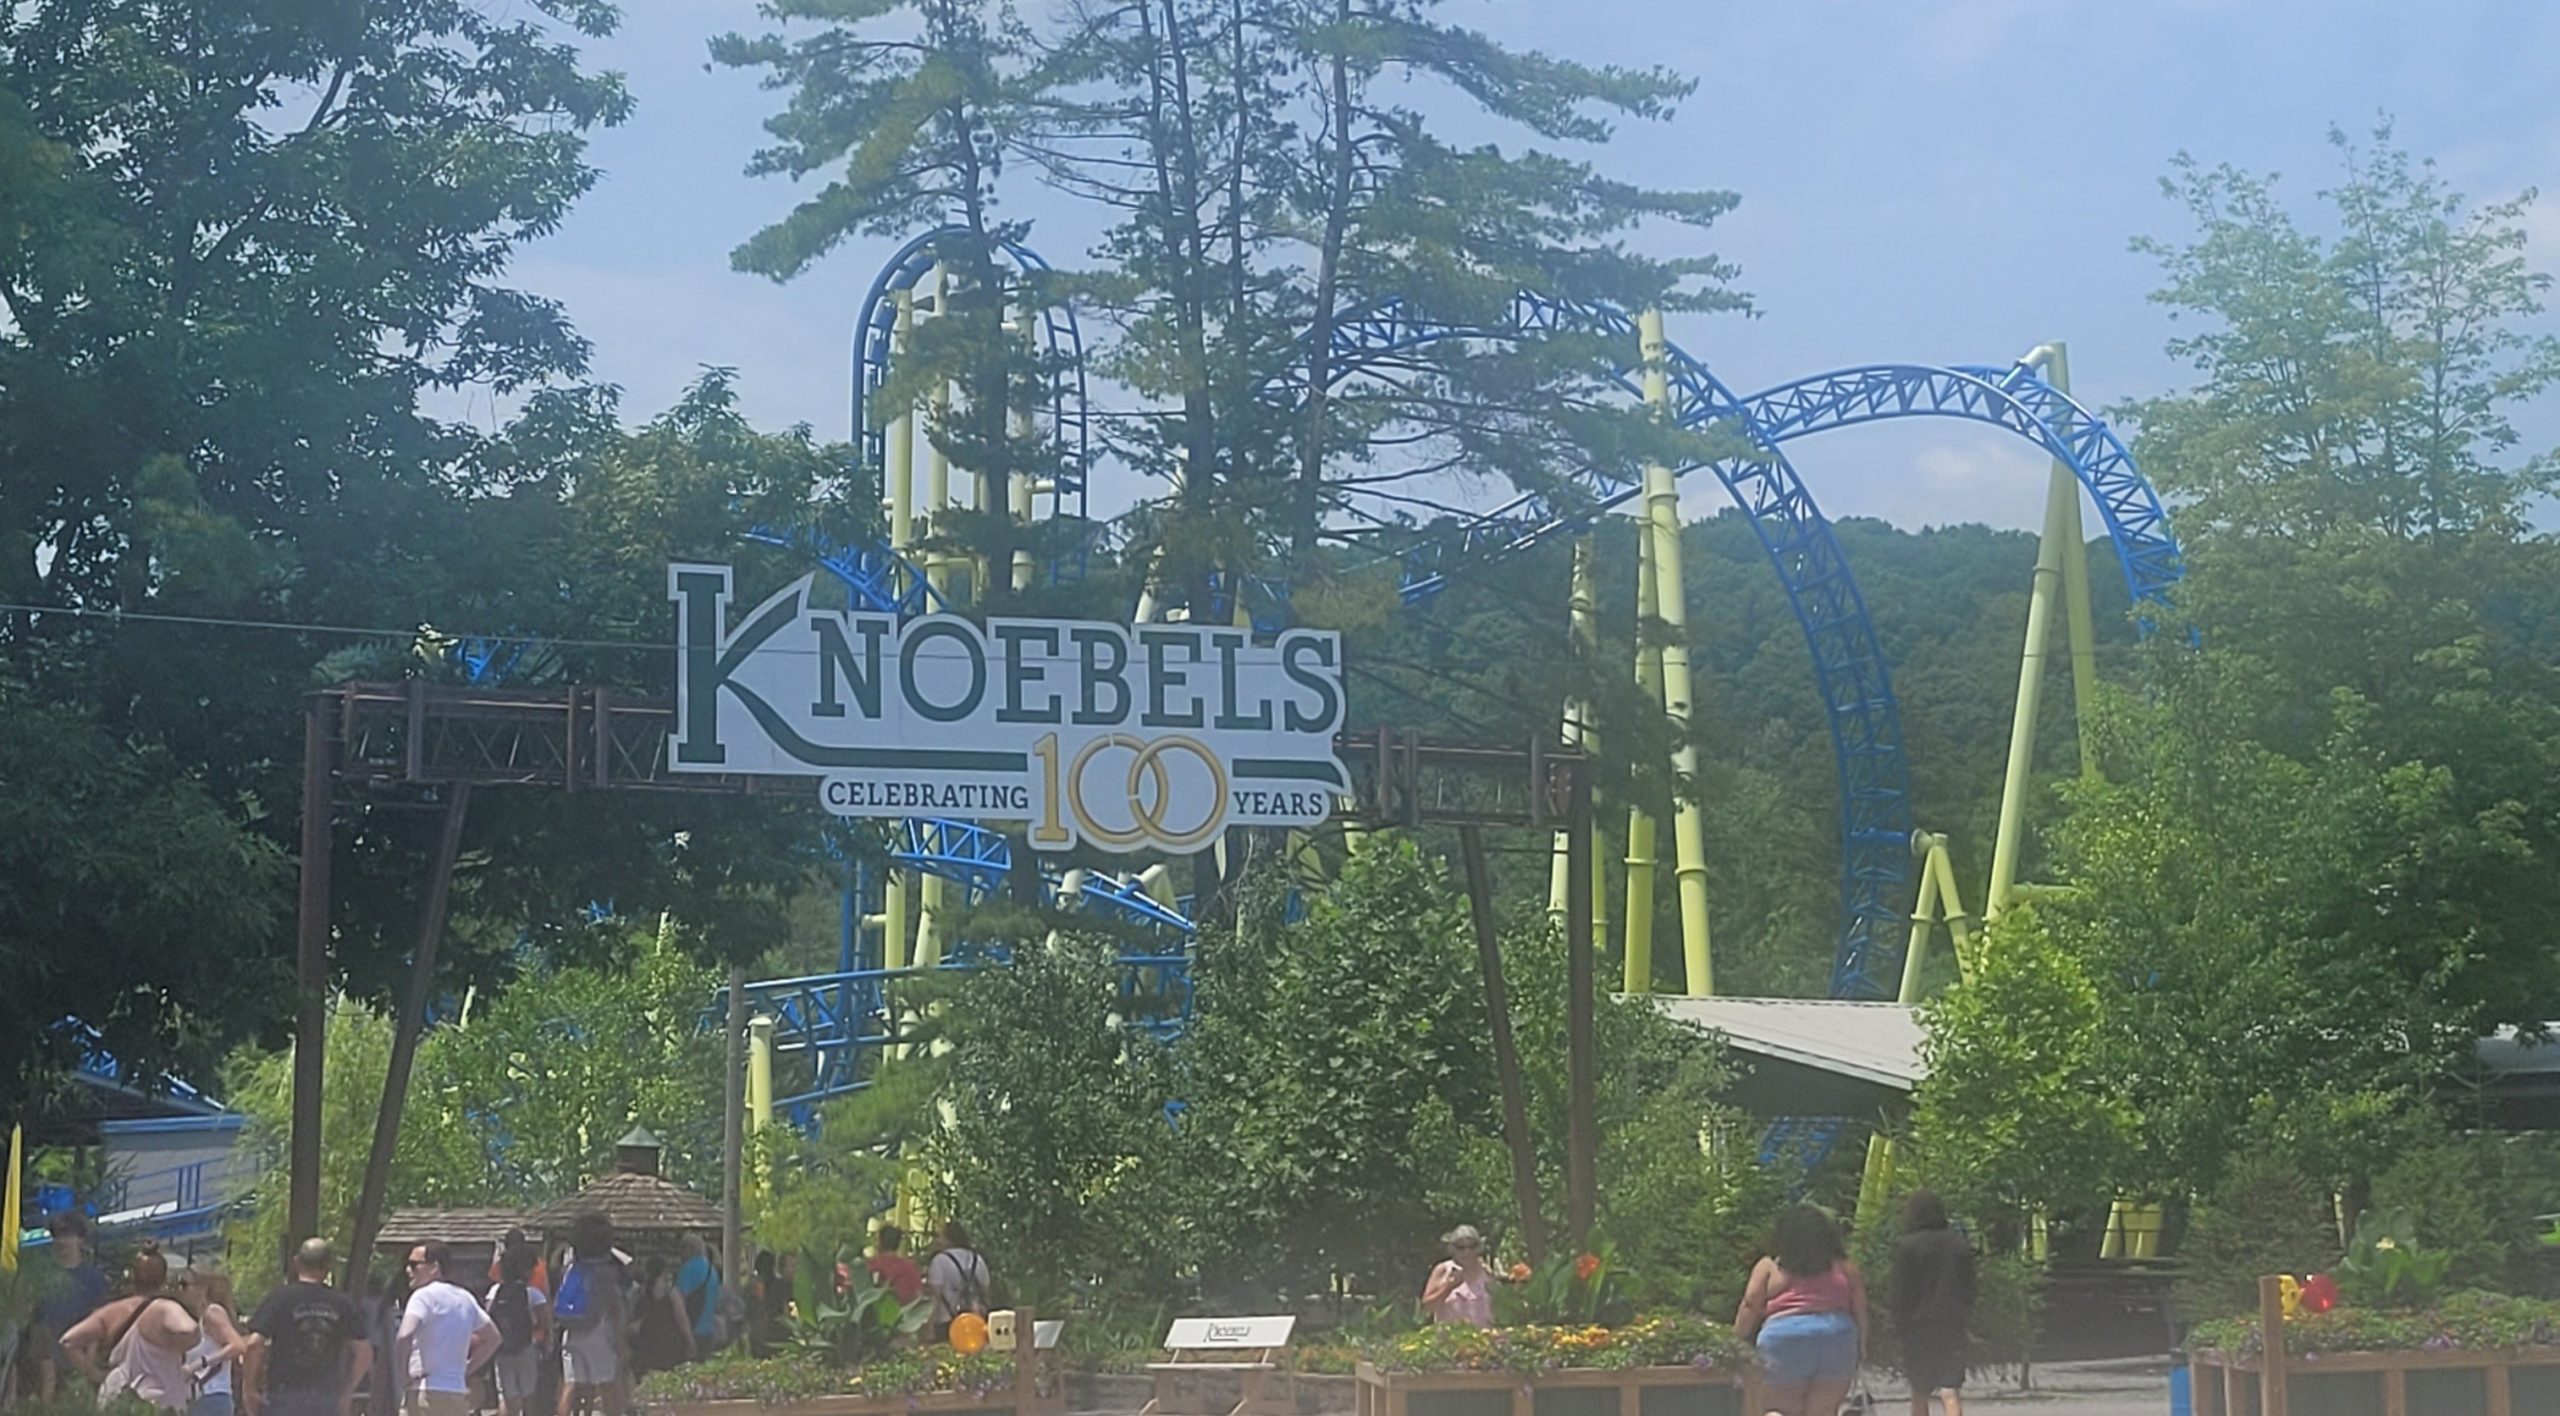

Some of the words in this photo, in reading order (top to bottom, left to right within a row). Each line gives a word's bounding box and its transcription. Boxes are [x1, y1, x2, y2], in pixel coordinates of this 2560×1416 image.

[677, 571, 1338, 771] KNOEBELS
[827, 781, 1029, 810] CELEBRATING
[1032, 731, 1229, 845] 100
[1233, 791, 1323, 817] YEARS
